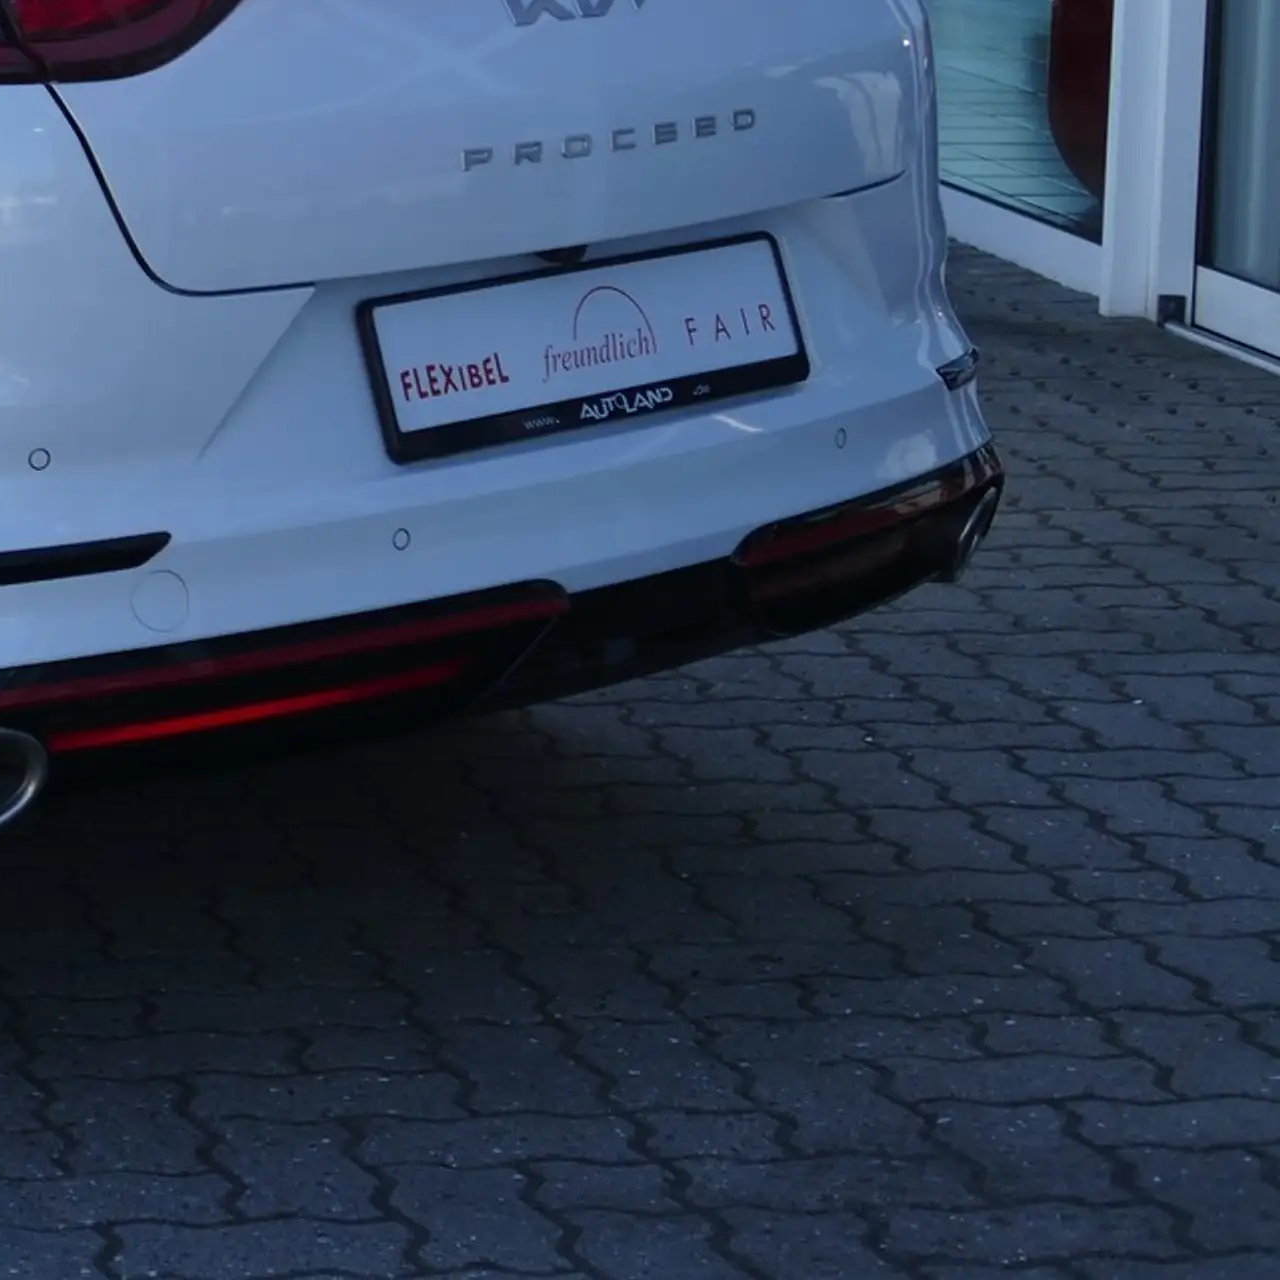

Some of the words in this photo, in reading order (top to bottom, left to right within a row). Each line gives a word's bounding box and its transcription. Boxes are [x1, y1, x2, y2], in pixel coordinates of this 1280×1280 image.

[460, 108, 756, 172] PROCEED
[400, 352, 510, 402] FLEXIBEL
[542, 327, 651, 383] freundlich
[684, 303, 776, 347] FAIR
[579, 386, 673, 420] AUTOLAND
